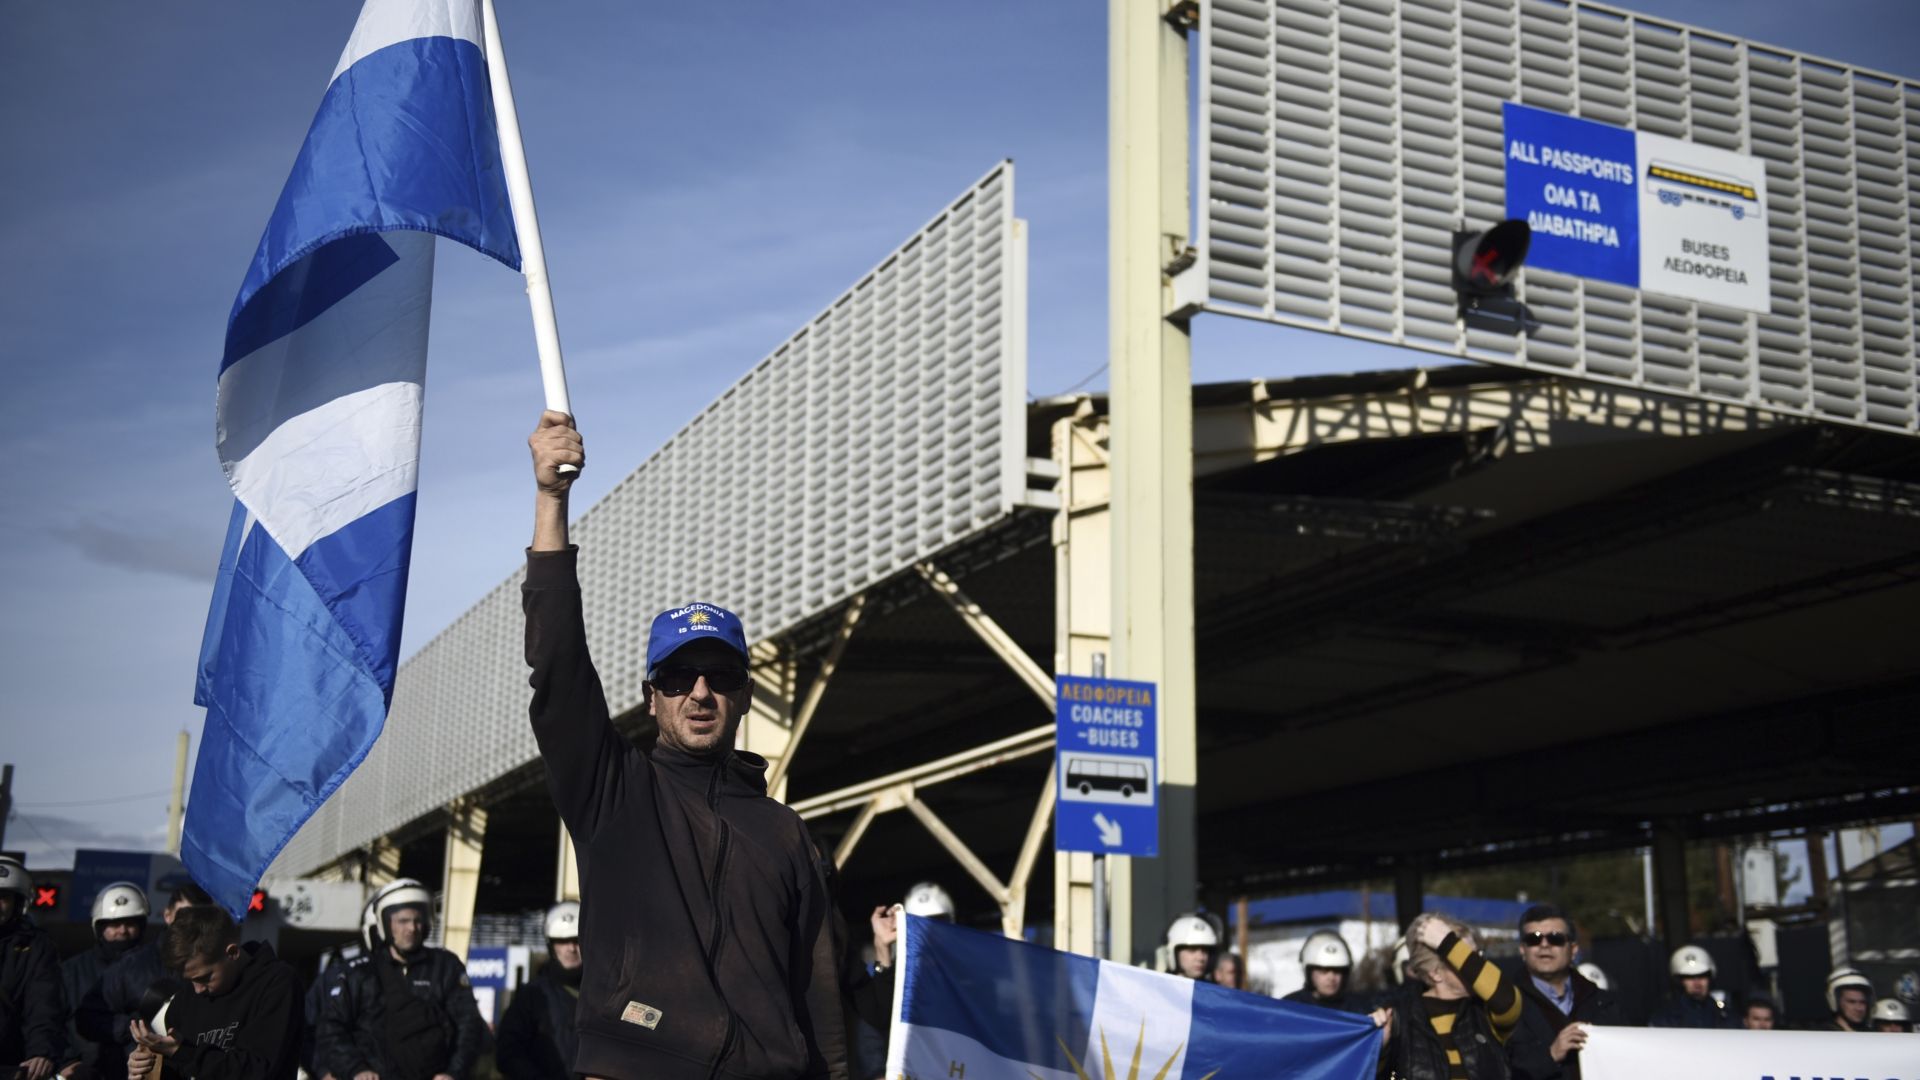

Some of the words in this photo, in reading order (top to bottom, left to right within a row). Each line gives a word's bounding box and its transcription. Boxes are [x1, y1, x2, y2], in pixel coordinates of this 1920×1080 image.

[1509, 139, 1540, 165] ALL
[1541, 146, 1633, 185] PASSPORTS
[1543, 182, 1578, 210] ΟΛΑ
[1579, 190, 1601, 214] ΤΑ
[1528, 211, 1619, 247] ΔΙΑΒΑΤΗΡΙΑ
[1682, 238, 1730, 262] BUSES
[1663, 255, 1748, 285] ΛΕΩΦΟΡΕΙΑ
[670, 604, 725, 620] MACEDONIA
[691, 624, 719, 632] GREEK
[1071, 705, 1143, 728] COACHES
